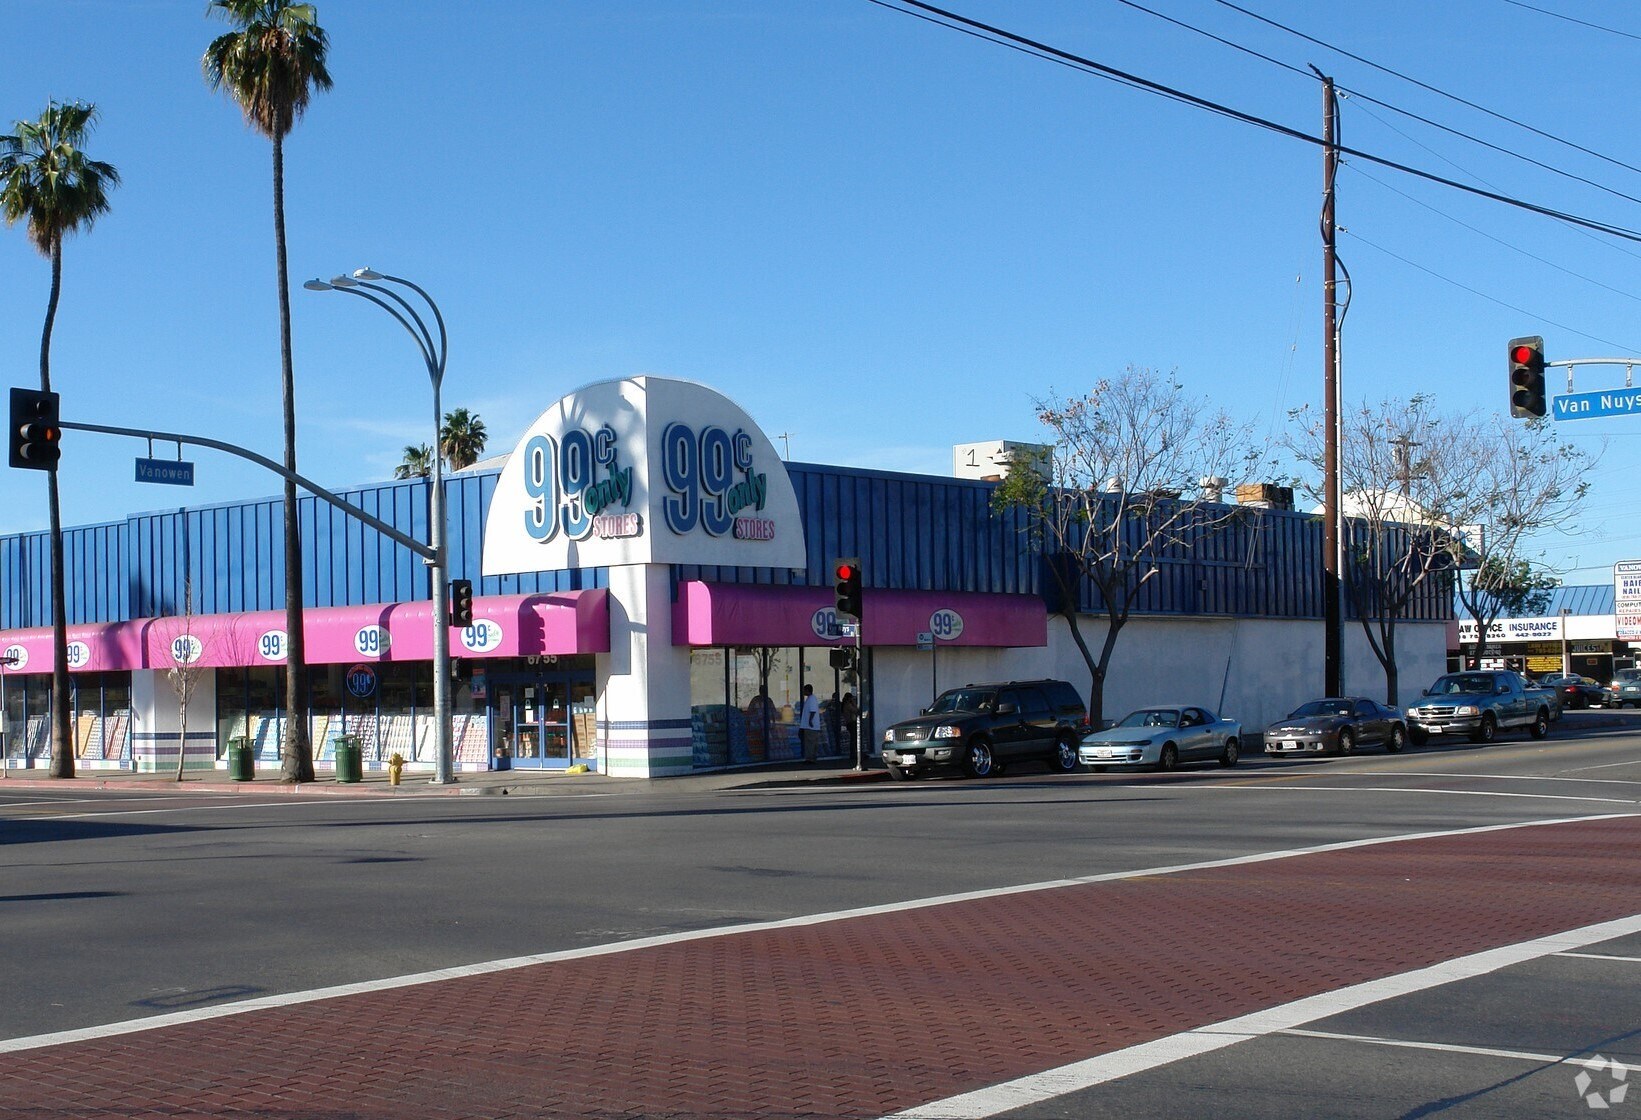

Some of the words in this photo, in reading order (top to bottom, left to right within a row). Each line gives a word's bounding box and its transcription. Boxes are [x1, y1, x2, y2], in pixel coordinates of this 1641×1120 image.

[1558, 398, 1590, 414] Van
[1601, 393, 1641, 411] Nuys
[965, 448, 980, 467] 1
[139, 464, 190, 480] Vanowen
[586, 463, 633, 515] only
[728, 467, 767, 515] only
[593, 513, 639, 538] STORES
[735, 518, 776, 540] STORES
[1509, 622, 1557, 631] INSURANCE
